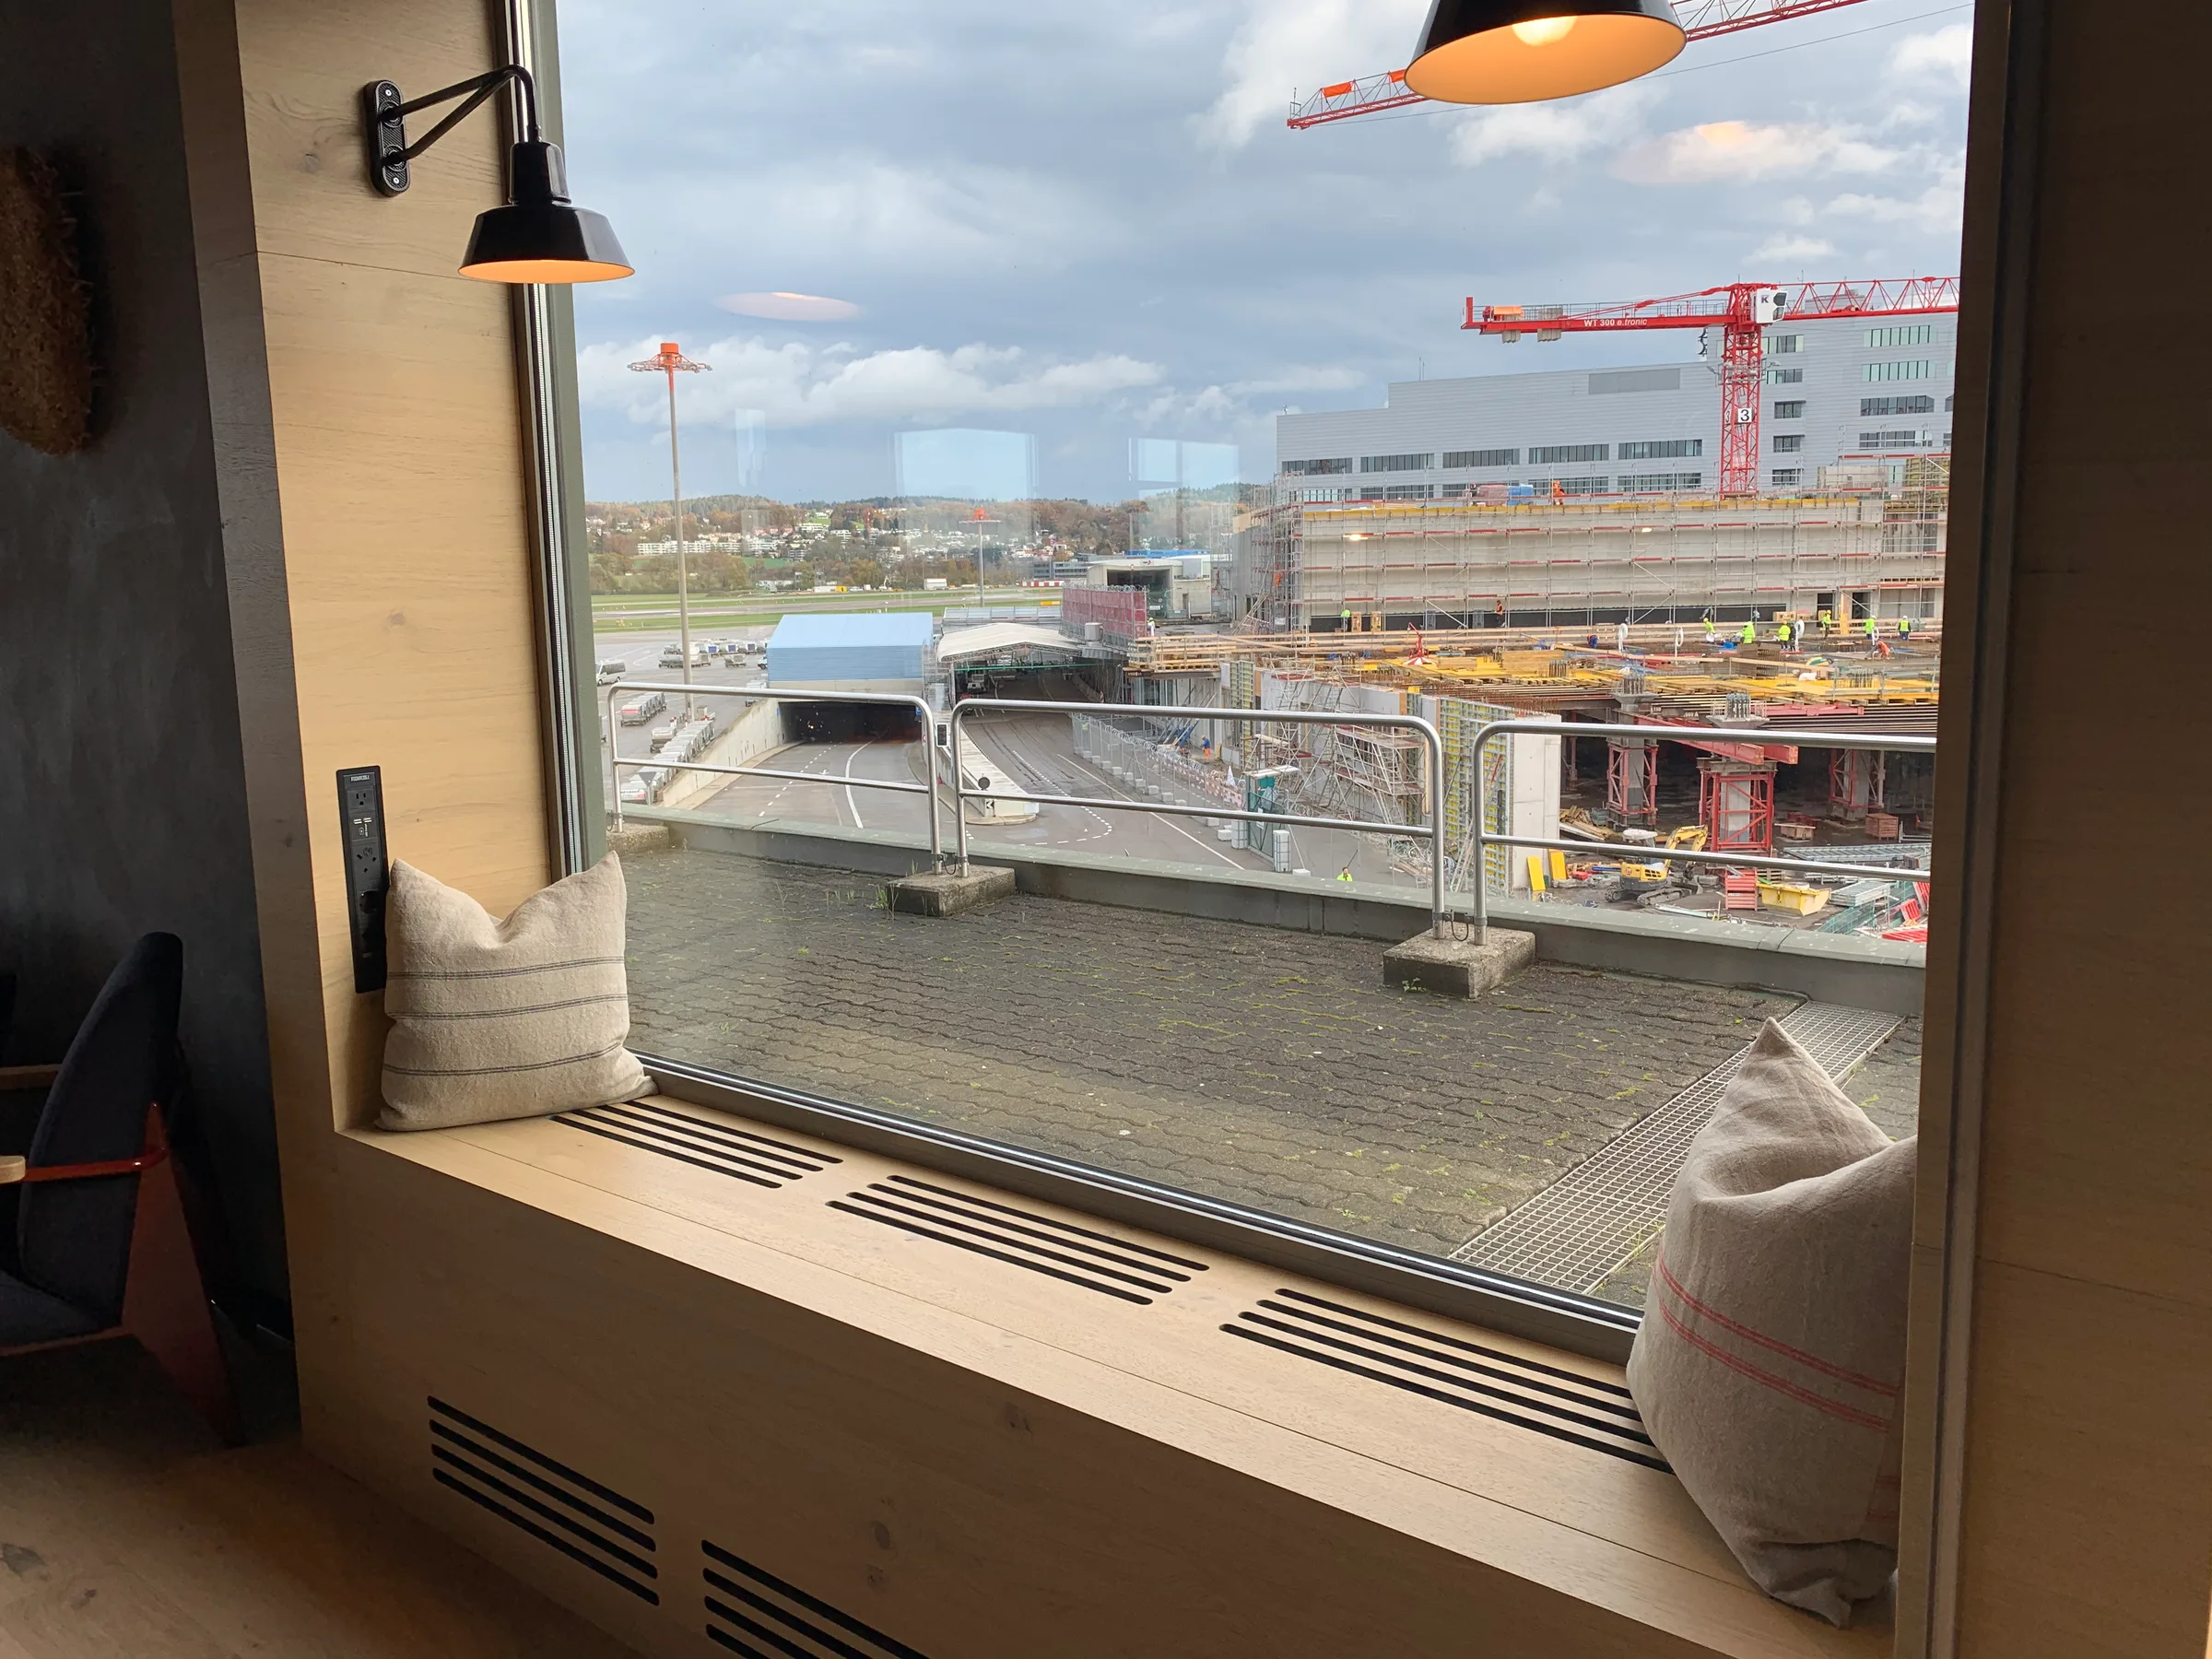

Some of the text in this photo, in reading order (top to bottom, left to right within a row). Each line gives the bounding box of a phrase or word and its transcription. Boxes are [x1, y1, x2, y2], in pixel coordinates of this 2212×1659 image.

[1761, 295, 1769, 303] K
[1617, 318, 1647, 326] e.tronic
[1740, 408, 1750, 422] 3
